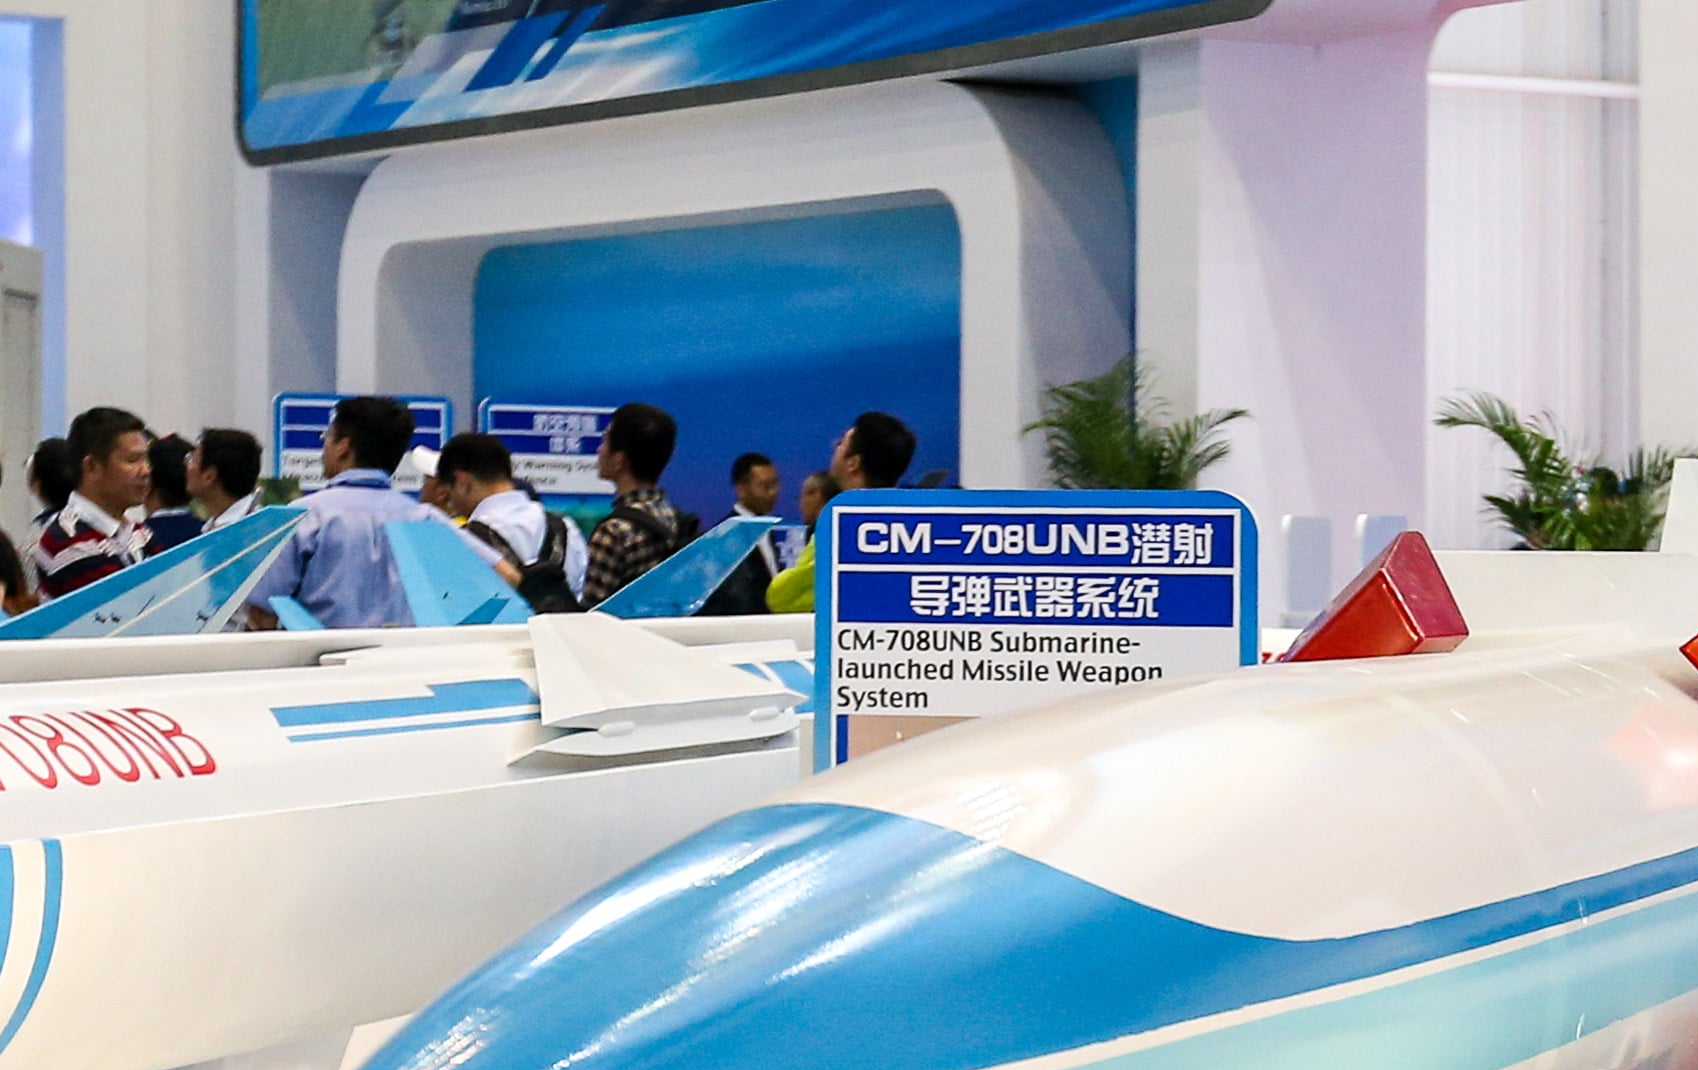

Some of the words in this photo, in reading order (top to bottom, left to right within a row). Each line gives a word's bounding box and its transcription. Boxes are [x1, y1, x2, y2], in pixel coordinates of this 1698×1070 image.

[856, 521, 1214, 565] CM-708UNB潜射
[909, 575, 1159, 619] 导弹武器系统
[837, 628, 982, 652] CM-708UNB
[990, 631, 1141, 656] Submarine-
[837, 657, 954, 682] launched
[963, 660, 1049, 683] Missile
[1056, 661, 1163, 686] Weapon
[837, 687, 929, 712] System
[0, 708, 216, 791] 08UNB
